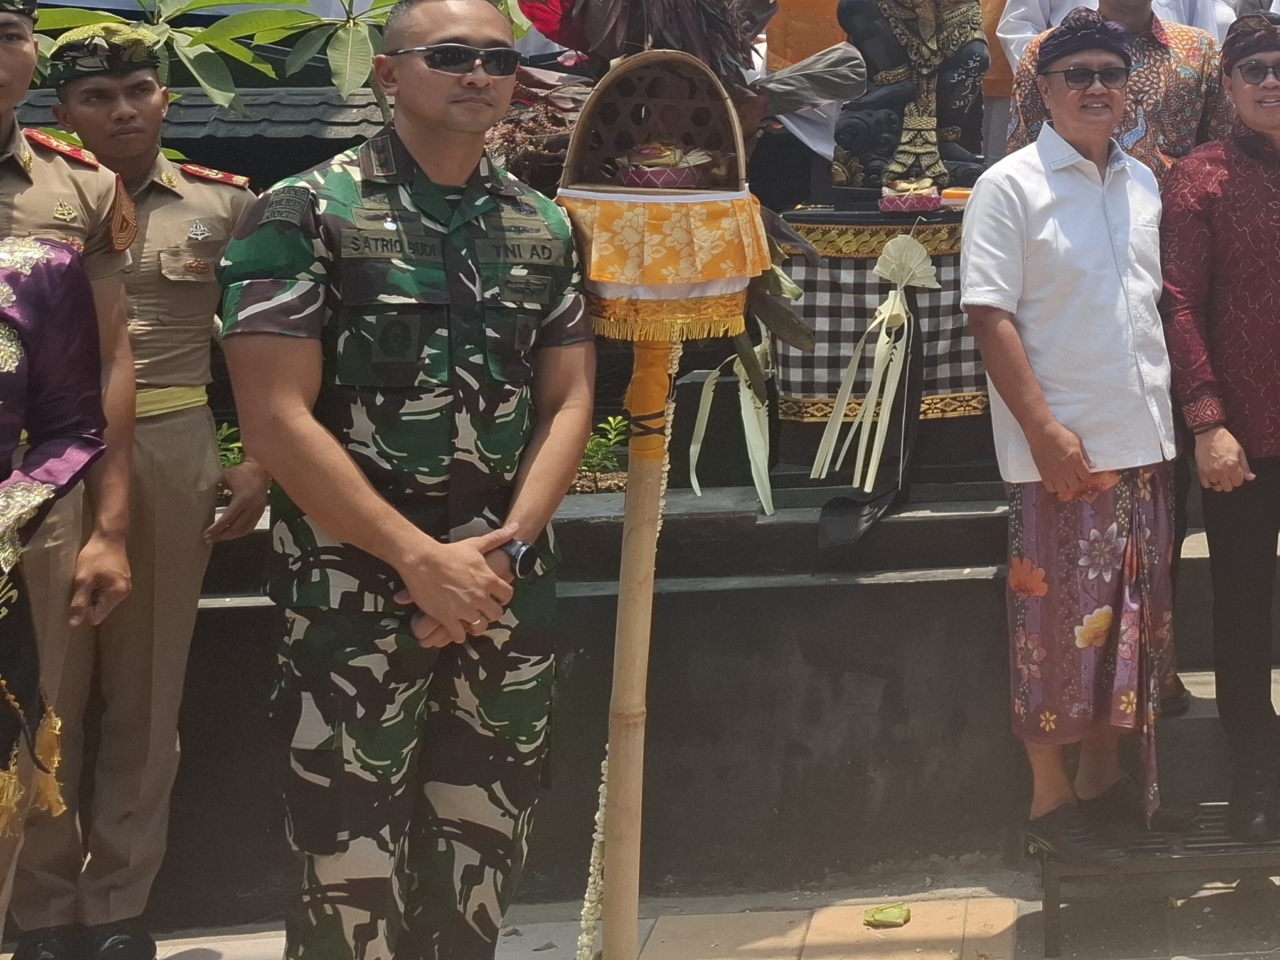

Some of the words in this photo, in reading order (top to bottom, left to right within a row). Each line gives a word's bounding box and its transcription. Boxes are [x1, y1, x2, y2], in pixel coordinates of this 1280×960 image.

[350, 236, 403, 253] SATRIO
[492, 243, 522, 259] TNI
[530, 243, 553, 260] AD
